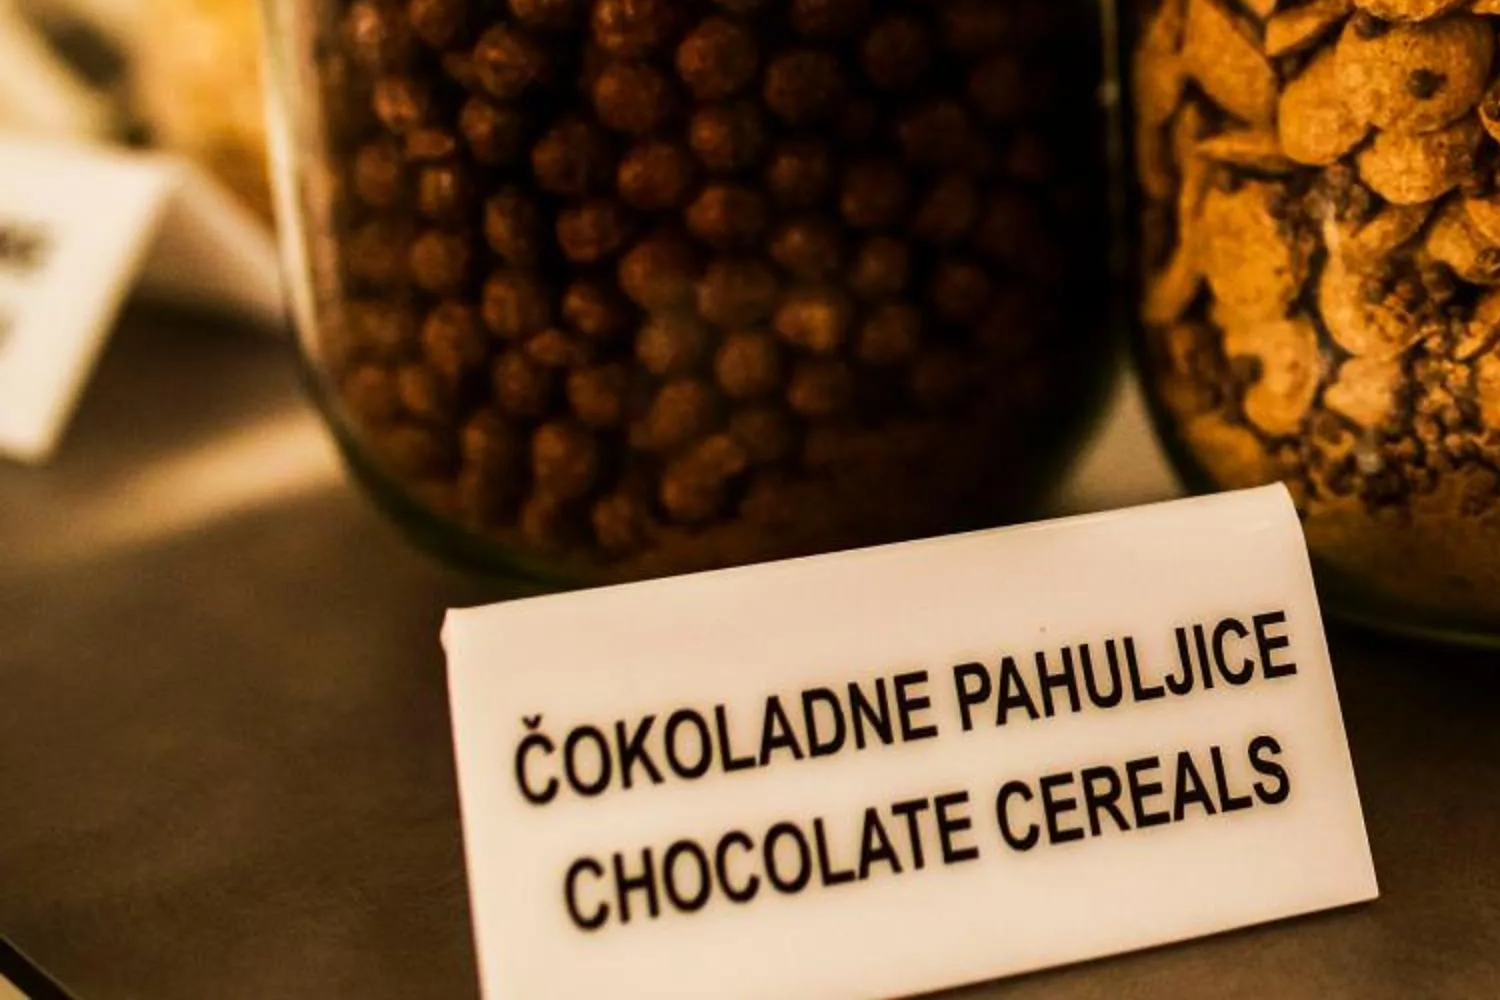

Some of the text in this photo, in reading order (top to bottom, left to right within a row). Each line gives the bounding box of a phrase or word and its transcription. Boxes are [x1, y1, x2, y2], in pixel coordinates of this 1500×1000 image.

[513, 610, 1298, 806] ČOKOLADNE PAHULJICE
[562, 735, 1291, 932] CHOCOLATE CEREALS
